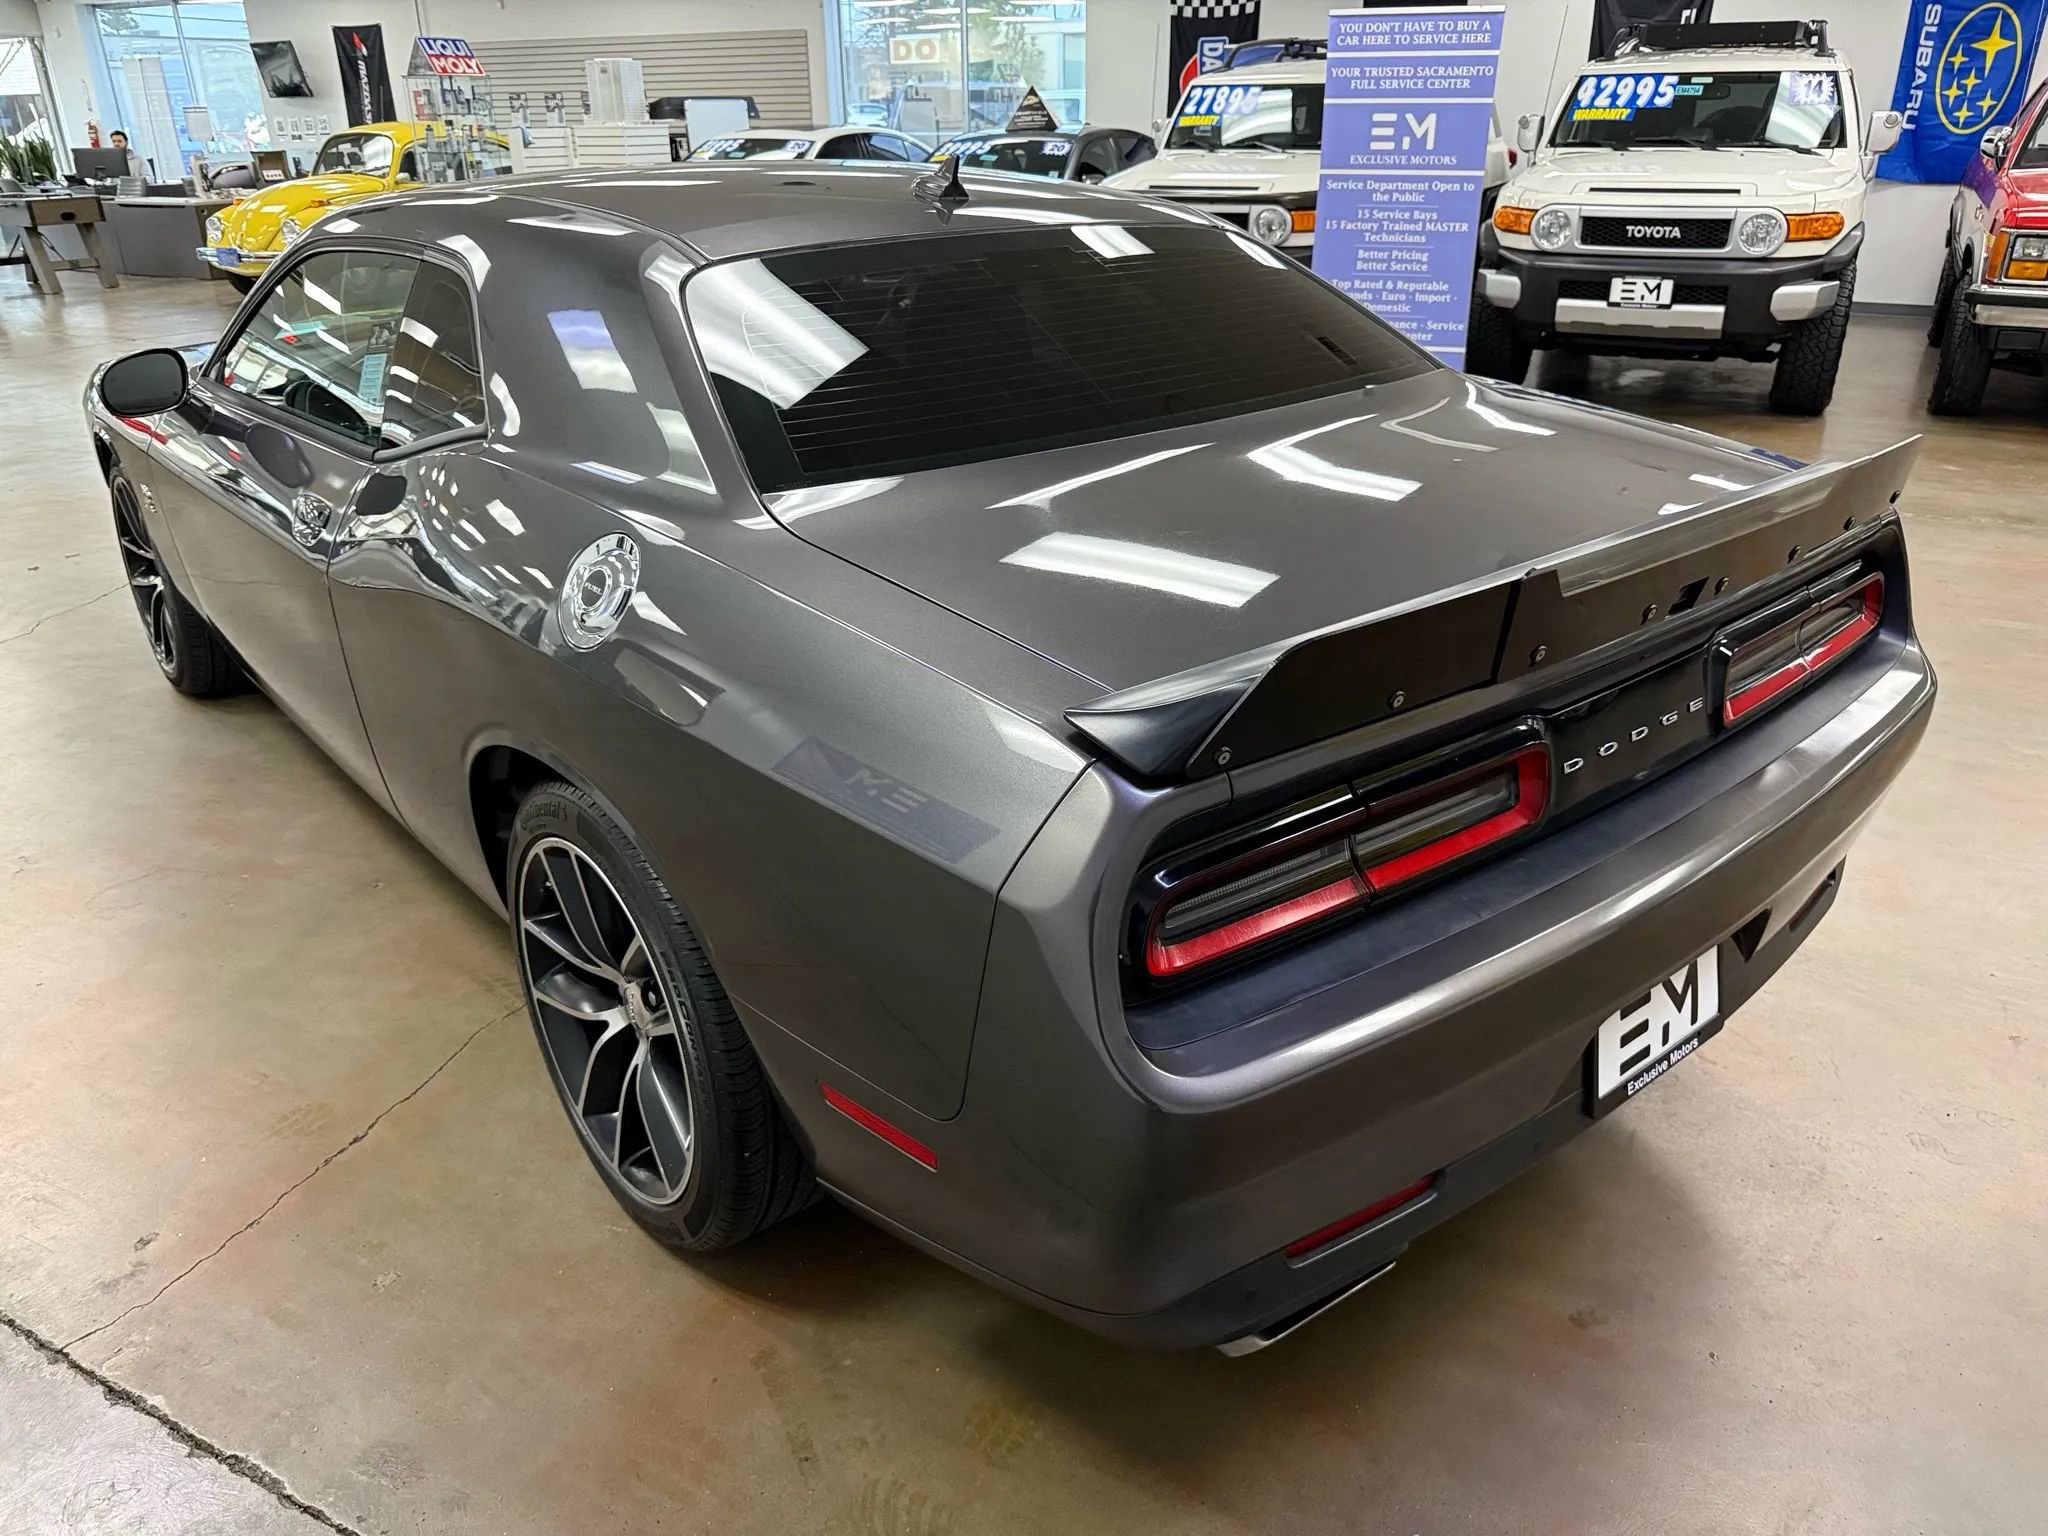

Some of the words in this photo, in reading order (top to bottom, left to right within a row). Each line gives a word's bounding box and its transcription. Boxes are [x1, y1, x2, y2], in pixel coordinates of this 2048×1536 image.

[1339, 23, 1363, 33] YOU
[1365, 22, 1401, 33] DON'T
[1403, 21, 1435, 32] HAVE
[1438, 21, 1454, 31] TO
[1456, 20, 1480, 31] BUY
[1482, 20, 1491, 30] A
[1336, 35, 1359, 46] CAR
[1362, 34, 1391, 45] HERE
[1394, 34, 1410, 44] TO
[1412, 33, 1458, 44] SERVICE
[1461, 33, 1492, 43] HERE
[420, 38, 473, 56] LIQUI
[430, 56, 482, 74] MOLY
[1331, 67, 1361, 77] YOUR
[1363, 66, 1414, 77] TRUSTED
[1416, 65, 1494, 76] SACRAMENTO
[1901, 3, 1943, 130] SUBARU
[1350, 79, 1377, 89] FULL
[1379, 79, 1424, 89] SERVICE
[1426, 78, 1471, 89] CENTER
[1577, 75, 1680, 108] 42995
[1573, 108, 1632, 120] WARRANTY
[1369, 112, 1437, 150] EM
[1350, 154, 1408, 165] EXCLUSIVE
[1410, 155, 1457, 165] MOTORS
[1326, 179, 1364, 190] Service
[1366, 180, 1429, 192] Department
[1431, 181, 1462, 192] Open
[1463, 181, 1475, 191] to
[1372, 192, 1390, 202] the
[1392, 192, 1425, 202] Public
[1357, 209, 1370, 219] 15
[1372, 209, 1410, 220] Service
[1413, 210, 1438, 222] Bays
[1325, 220, 1338, 230] 15
[1340, 220, 1379, 232] Factory
[1382, 221, 1423, 231] Trained
[1425, 222, 1469, 232] MASTER
[1625, 225, 1681, 239] TOYOTA
[1363, 232, 1427, 243] Technicians
[1357, 249, 1389, 259] Better
[1391, 250, 1429, 262] Pricing
[1355, 260, 1388, 271] Better
[1390, 261, 1428, 272] Service
[1330, 279, 1351, 291] Top
[1353, 280, 1383, 290] Rated
[1385, 280, 1394, 290] &
[1396, 281, 1449, 292] Reputable
[1620, 281, 1662, 302] EM
[1381, 292, 1406, 301] Euro
[1415, 293, 1452, 304] Import
[1362, 302, 1412, 313] Domestic
[1426, 320, 1465, 331] Service
[584, 582, 603, 595] FUEL
[1563, 697, 1704, 775] DODGE
[1619, 958, 1699, 1077] EM
[1627, 1060, 1669, 1097] Exclusive
[1670, 1037, 1699, 1067] Motors
